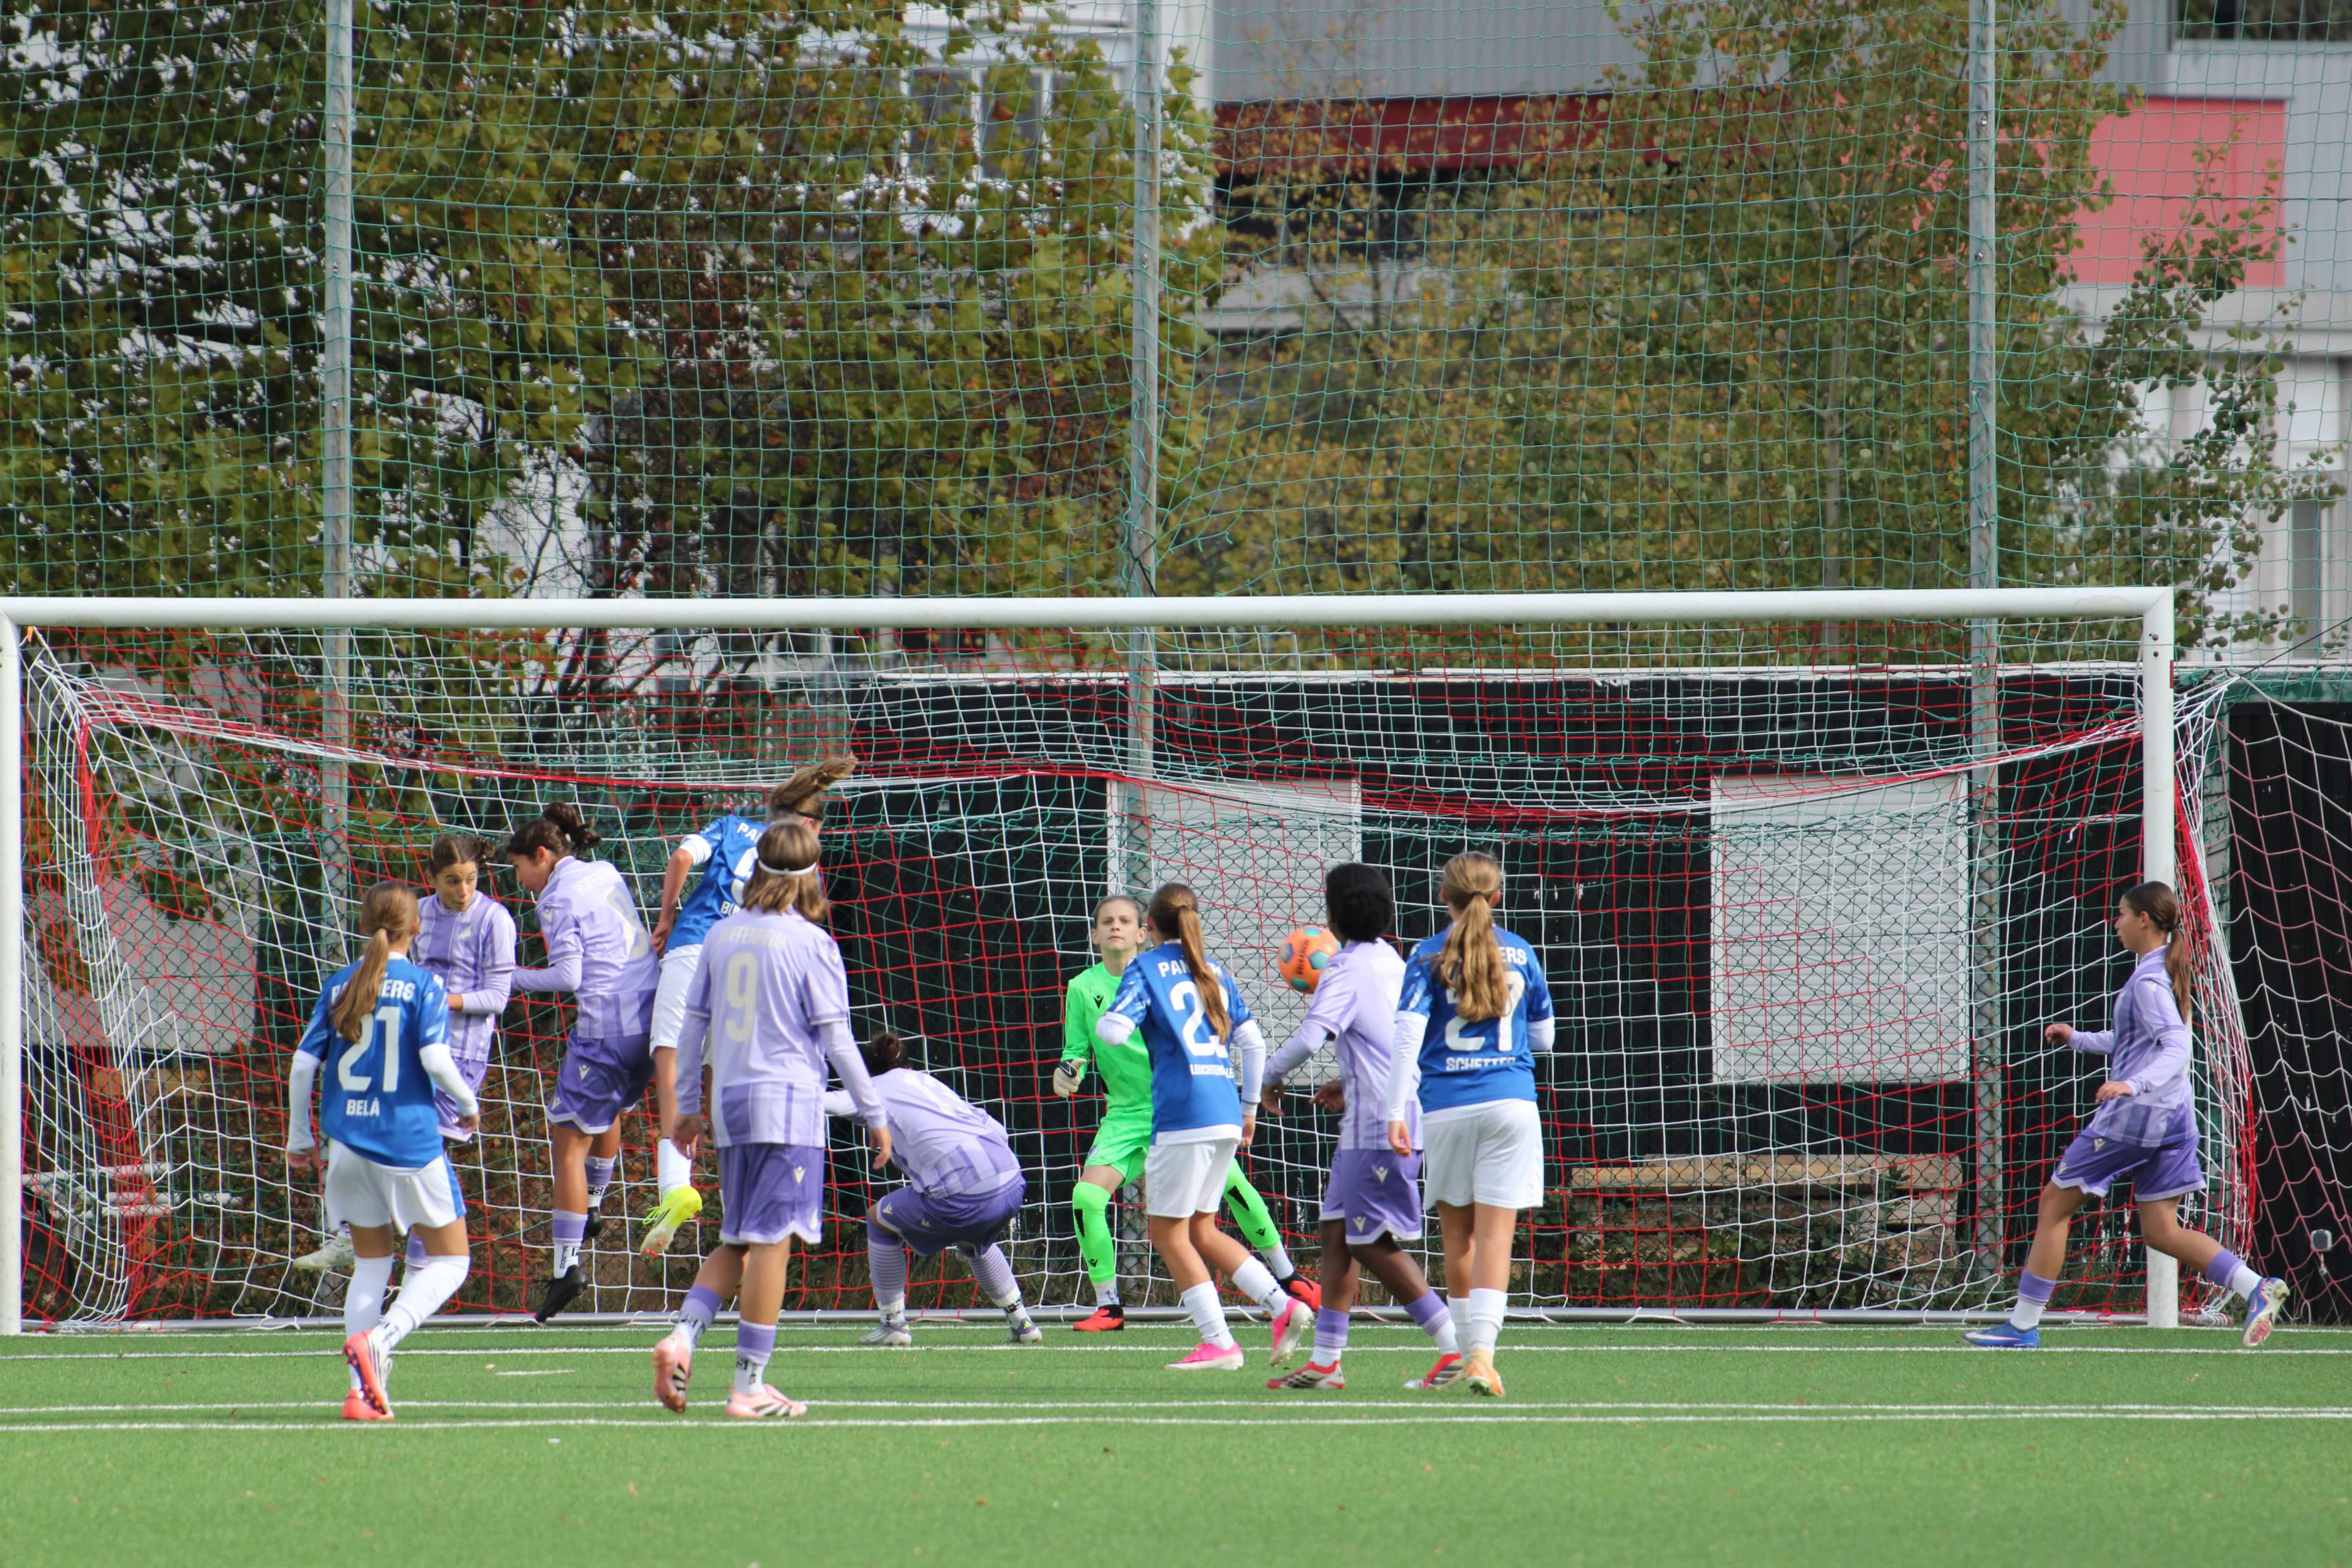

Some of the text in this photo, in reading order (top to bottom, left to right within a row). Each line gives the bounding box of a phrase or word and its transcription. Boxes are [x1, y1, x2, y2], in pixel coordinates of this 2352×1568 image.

[726, 951, 759, 1042] 9
[1444, 970, 1525, 1052] 27
[336, 1006, 401, 1092] 21
